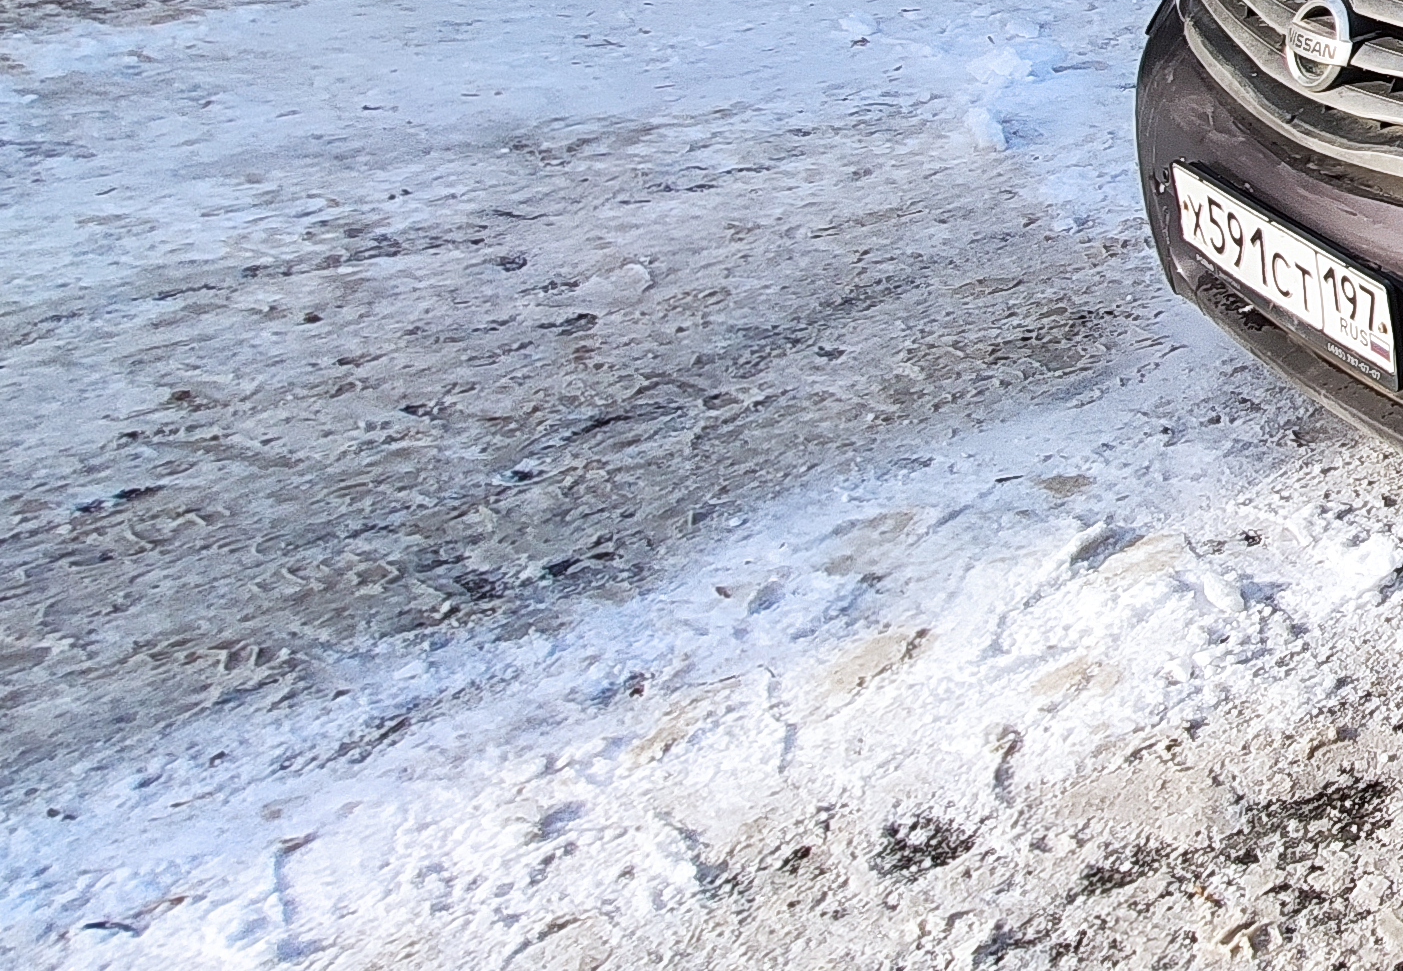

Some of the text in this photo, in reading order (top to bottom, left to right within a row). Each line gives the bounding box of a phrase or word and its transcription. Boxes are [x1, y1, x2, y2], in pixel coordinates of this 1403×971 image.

[1289, 27, 1338, 60] NISSAN
[1187, 194, 1377, 332] Х591СТ 197
[1340, 316, 1369, 347] RUS
